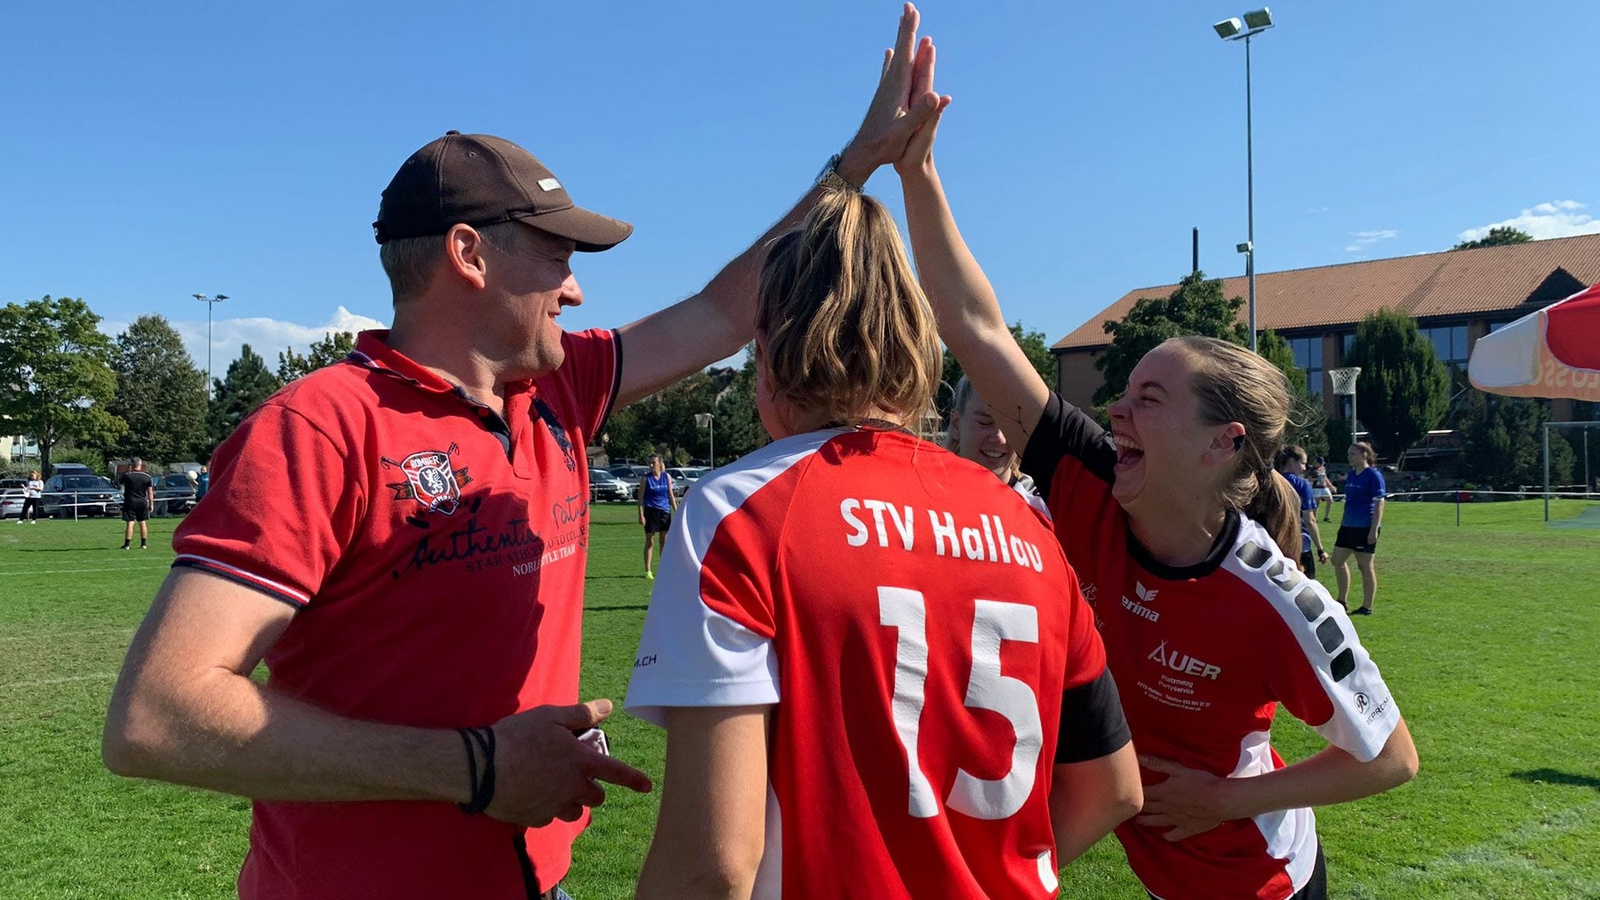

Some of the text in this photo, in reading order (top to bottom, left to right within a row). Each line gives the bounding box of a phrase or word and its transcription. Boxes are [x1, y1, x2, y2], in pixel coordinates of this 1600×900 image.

[839, 497, 1044, 573] STV Hallau
[1121, 595, 1160, 623] erima
[1147, 639, 1222, 681] AUER
[876, 585, 1043, 821] 15
